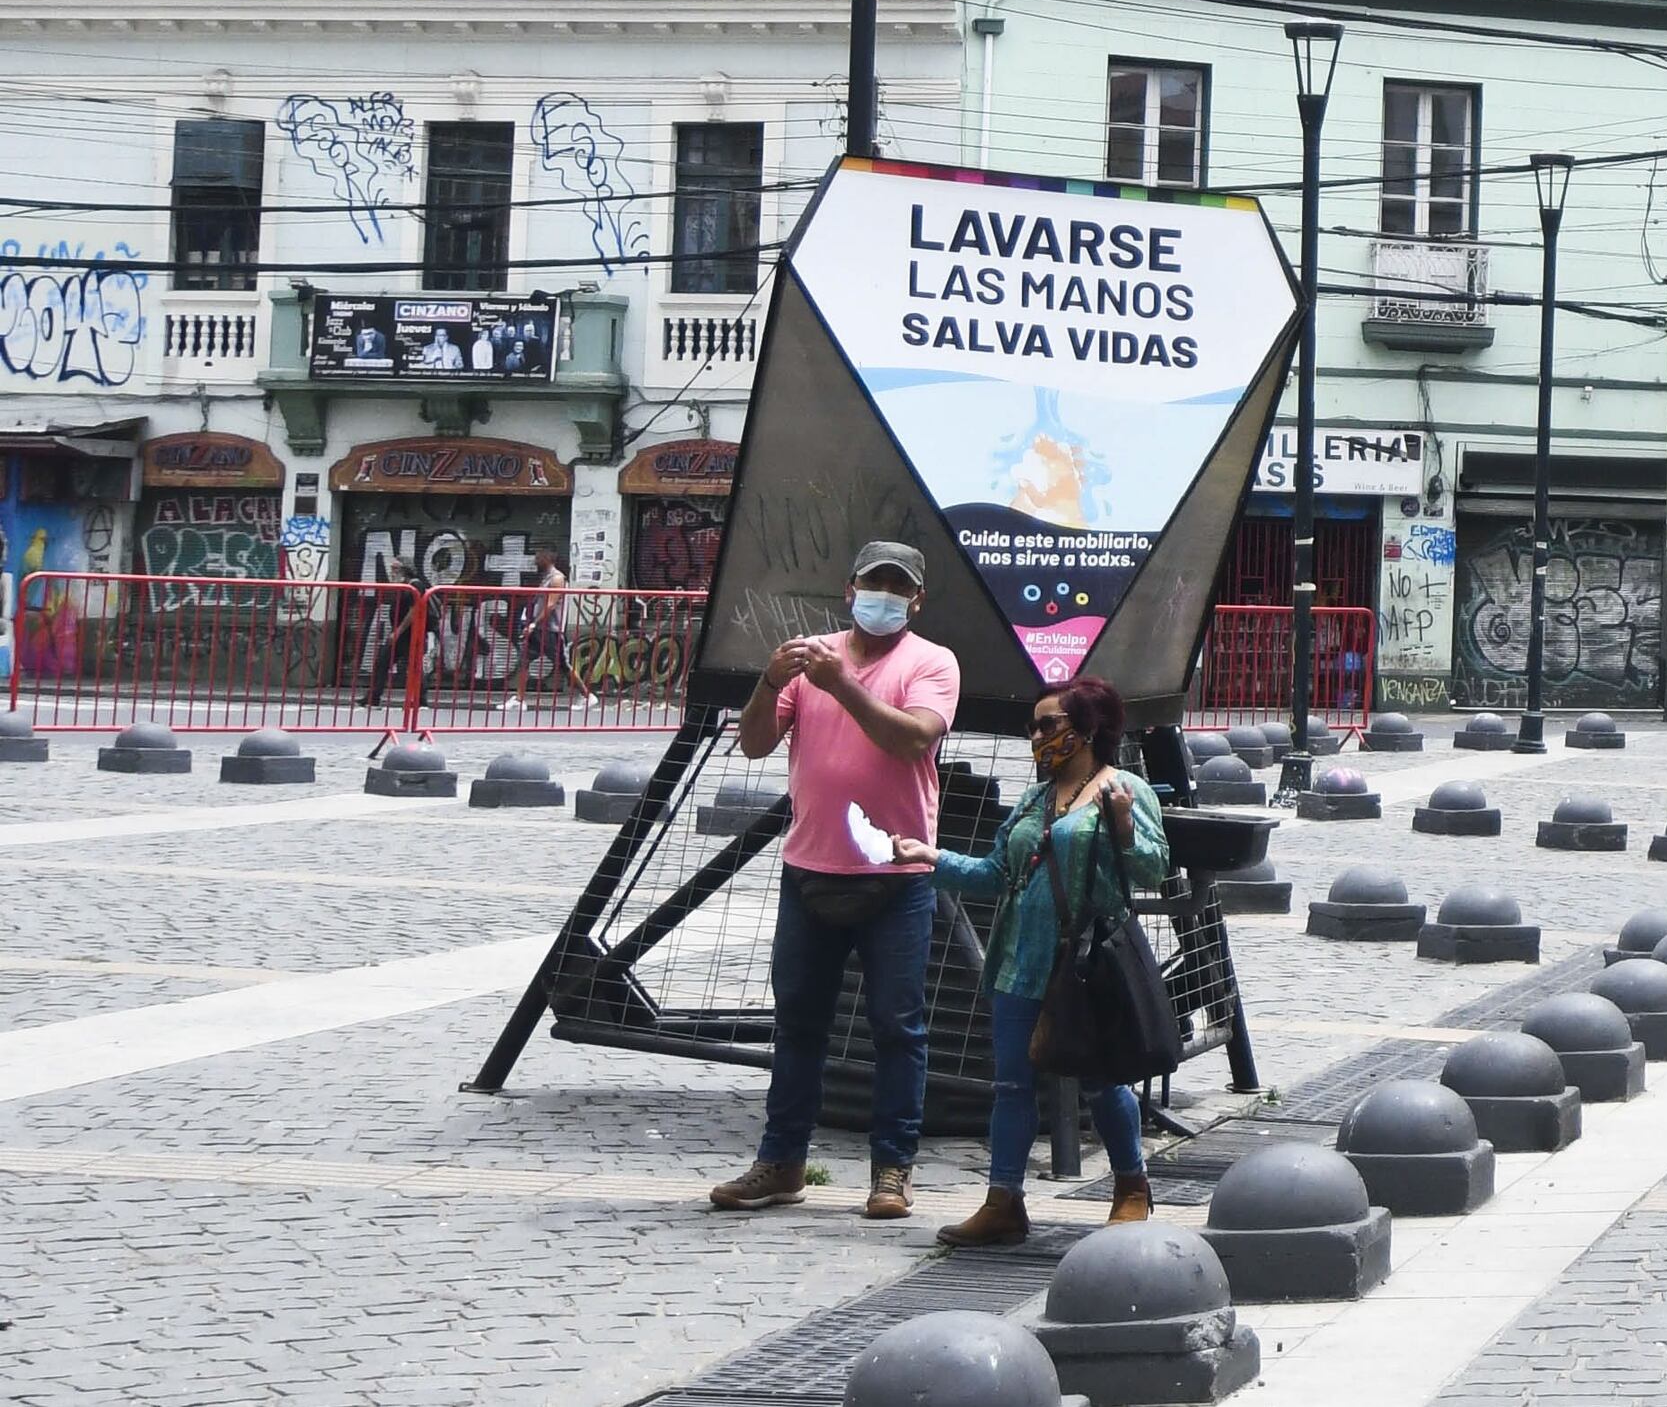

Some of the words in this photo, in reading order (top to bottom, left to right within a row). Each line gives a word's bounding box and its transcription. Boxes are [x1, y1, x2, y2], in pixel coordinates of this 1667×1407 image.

[910, 203, 1182, 273] LAVARSE
[909, 260, 1006, 305] LAS
[1021, 271, 1194, 321] MANOS
[399, 304, 469, 318] CINZANO
[396, 322, 433, 334] Jueves
[902, 312, 1054, 358] SALVA
[1067, 326, 1199, 369] VIDAS
[380, 448, 523, 482] CINZANO
[654, 450, 737, 476] CINZAN
[1354, 481, 1378, 491] Wine
[1388, 482, 1408, 492] Beer
[959, 529, 1010, 548] Cuida
[1014, 532, 1055, 549] este
[1058, 532, 1153, 551] mobiliario,
[360, 528, 467, 597] NO
[978, 551, 1012, 566] nos
[1016, 550, 1060, 567] sirve
[1064, 553, 1076, 567] a
[1079, 551, 1136, 567] todxs.
[1388, 568, 1412, 599] NO
[1388, 604, 1434, 642] AFP
[1025, 632, 1088, 646] #EnValpo
